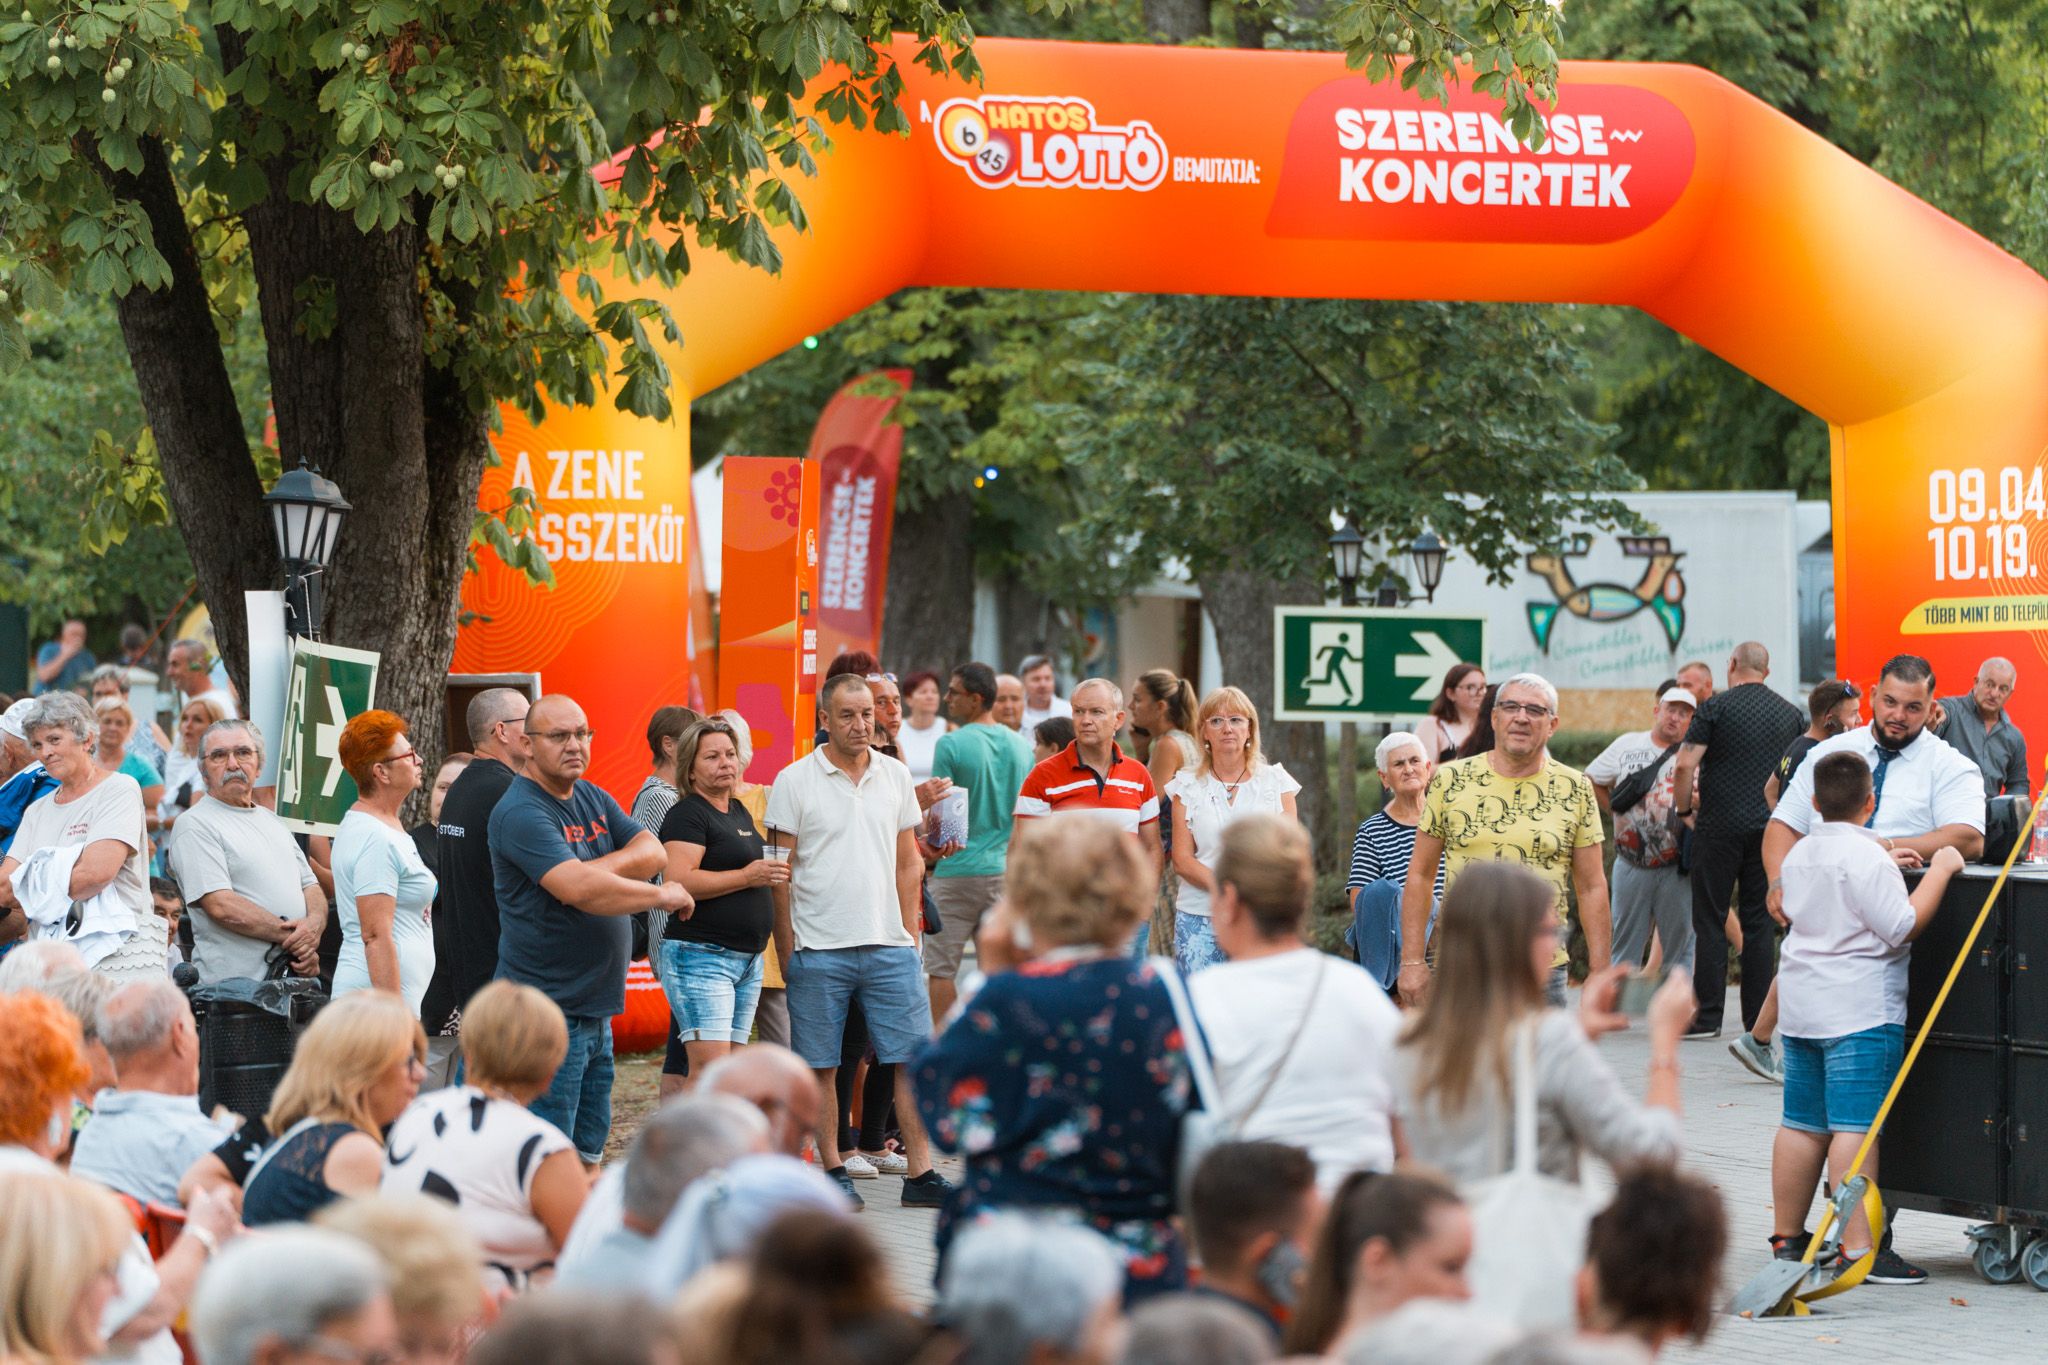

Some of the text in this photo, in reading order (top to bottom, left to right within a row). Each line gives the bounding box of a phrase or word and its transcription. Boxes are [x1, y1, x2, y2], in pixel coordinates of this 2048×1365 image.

[920, 99, 932, 123] A
[988, 104, 1089, 131] HATOS
[978, 147, 1004, 171] 45
[1173, 156, 1261, 185] BEMUTATJA:
[1338, 157, 1632, 208] KONCERTEK
[512, 450, 645, 500] A ZENE
[1928, 466, 2048, 523] 09.04
[513, 504, 685, 564] SSZEKÖT
[822, 483, 854, 609] SZERENCSE
[842, 475, 877, 611] KONCERTEK
[1927, 523, 2038, 581] 10.19.
[1924, 605, 1957, 625] TÖBB
[1960, 605, 1990, 623] MINT
[1994, 604, 2009, 622] 80
